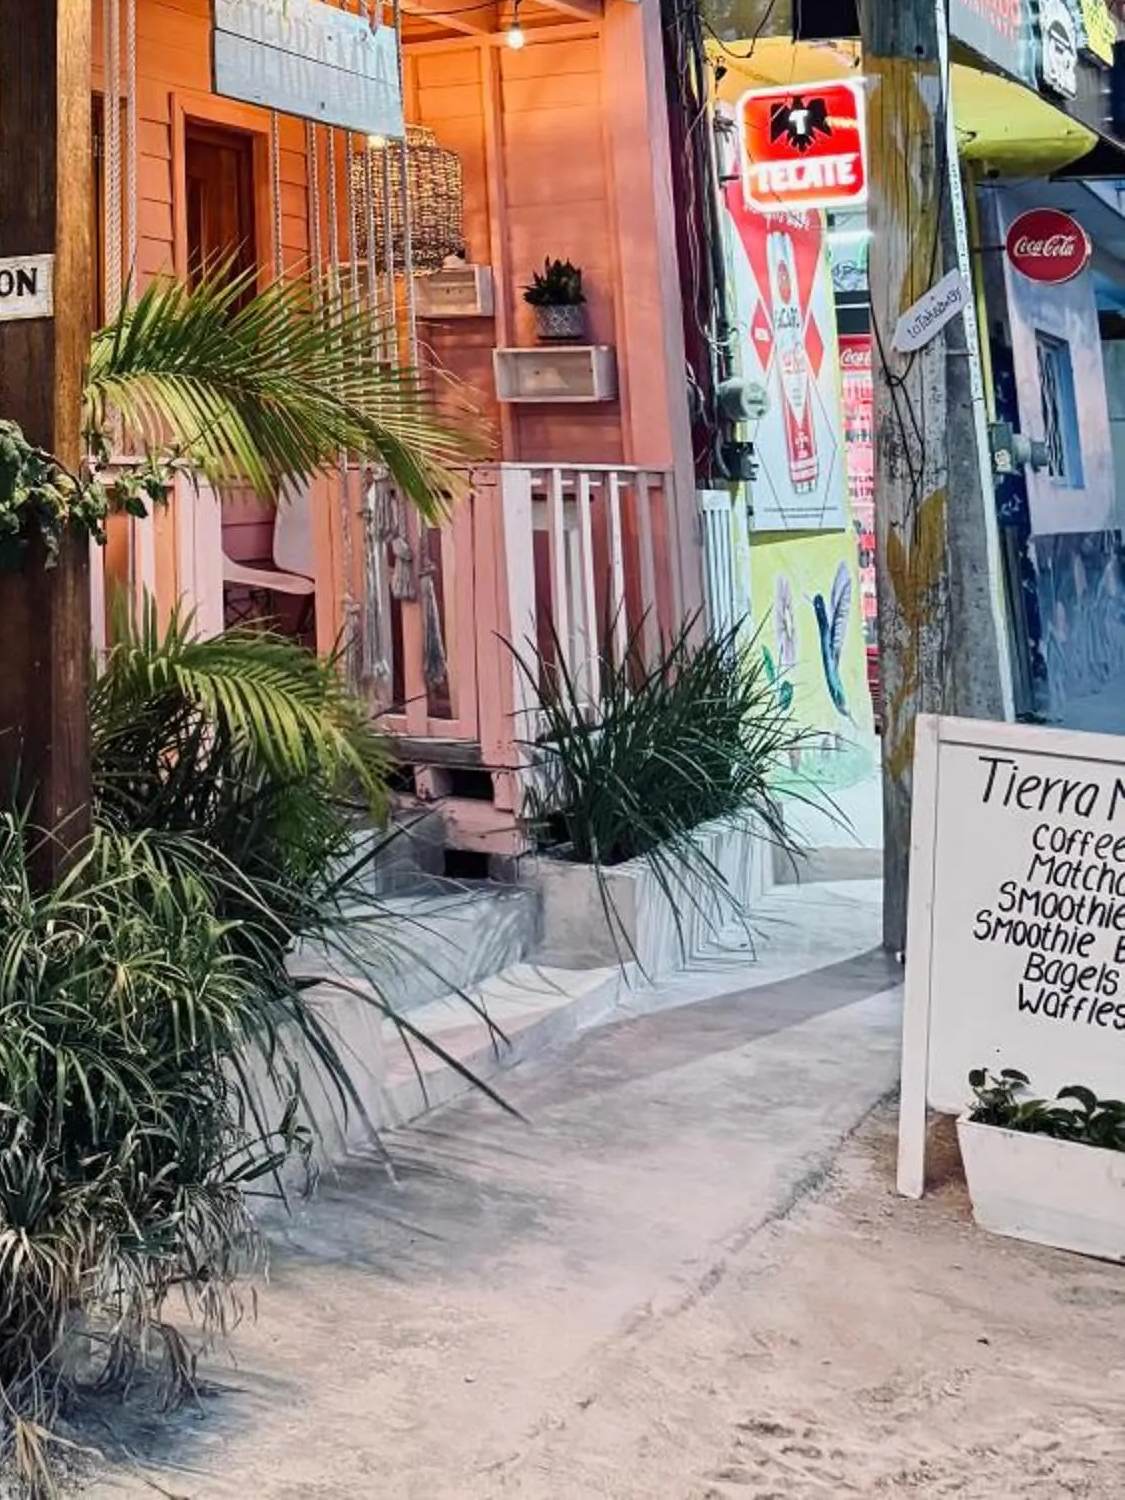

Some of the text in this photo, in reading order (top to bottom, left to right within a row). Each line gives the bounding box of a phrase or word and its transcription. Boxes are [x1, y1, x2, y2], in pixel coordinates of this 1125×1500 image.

[749, 154, 860, 193] TECATE
[978, 756, 1100, 818] Tierra
[1024, 952, 1120, 996] Bagels
[1018, 983, 1125, 1031] Waffles
